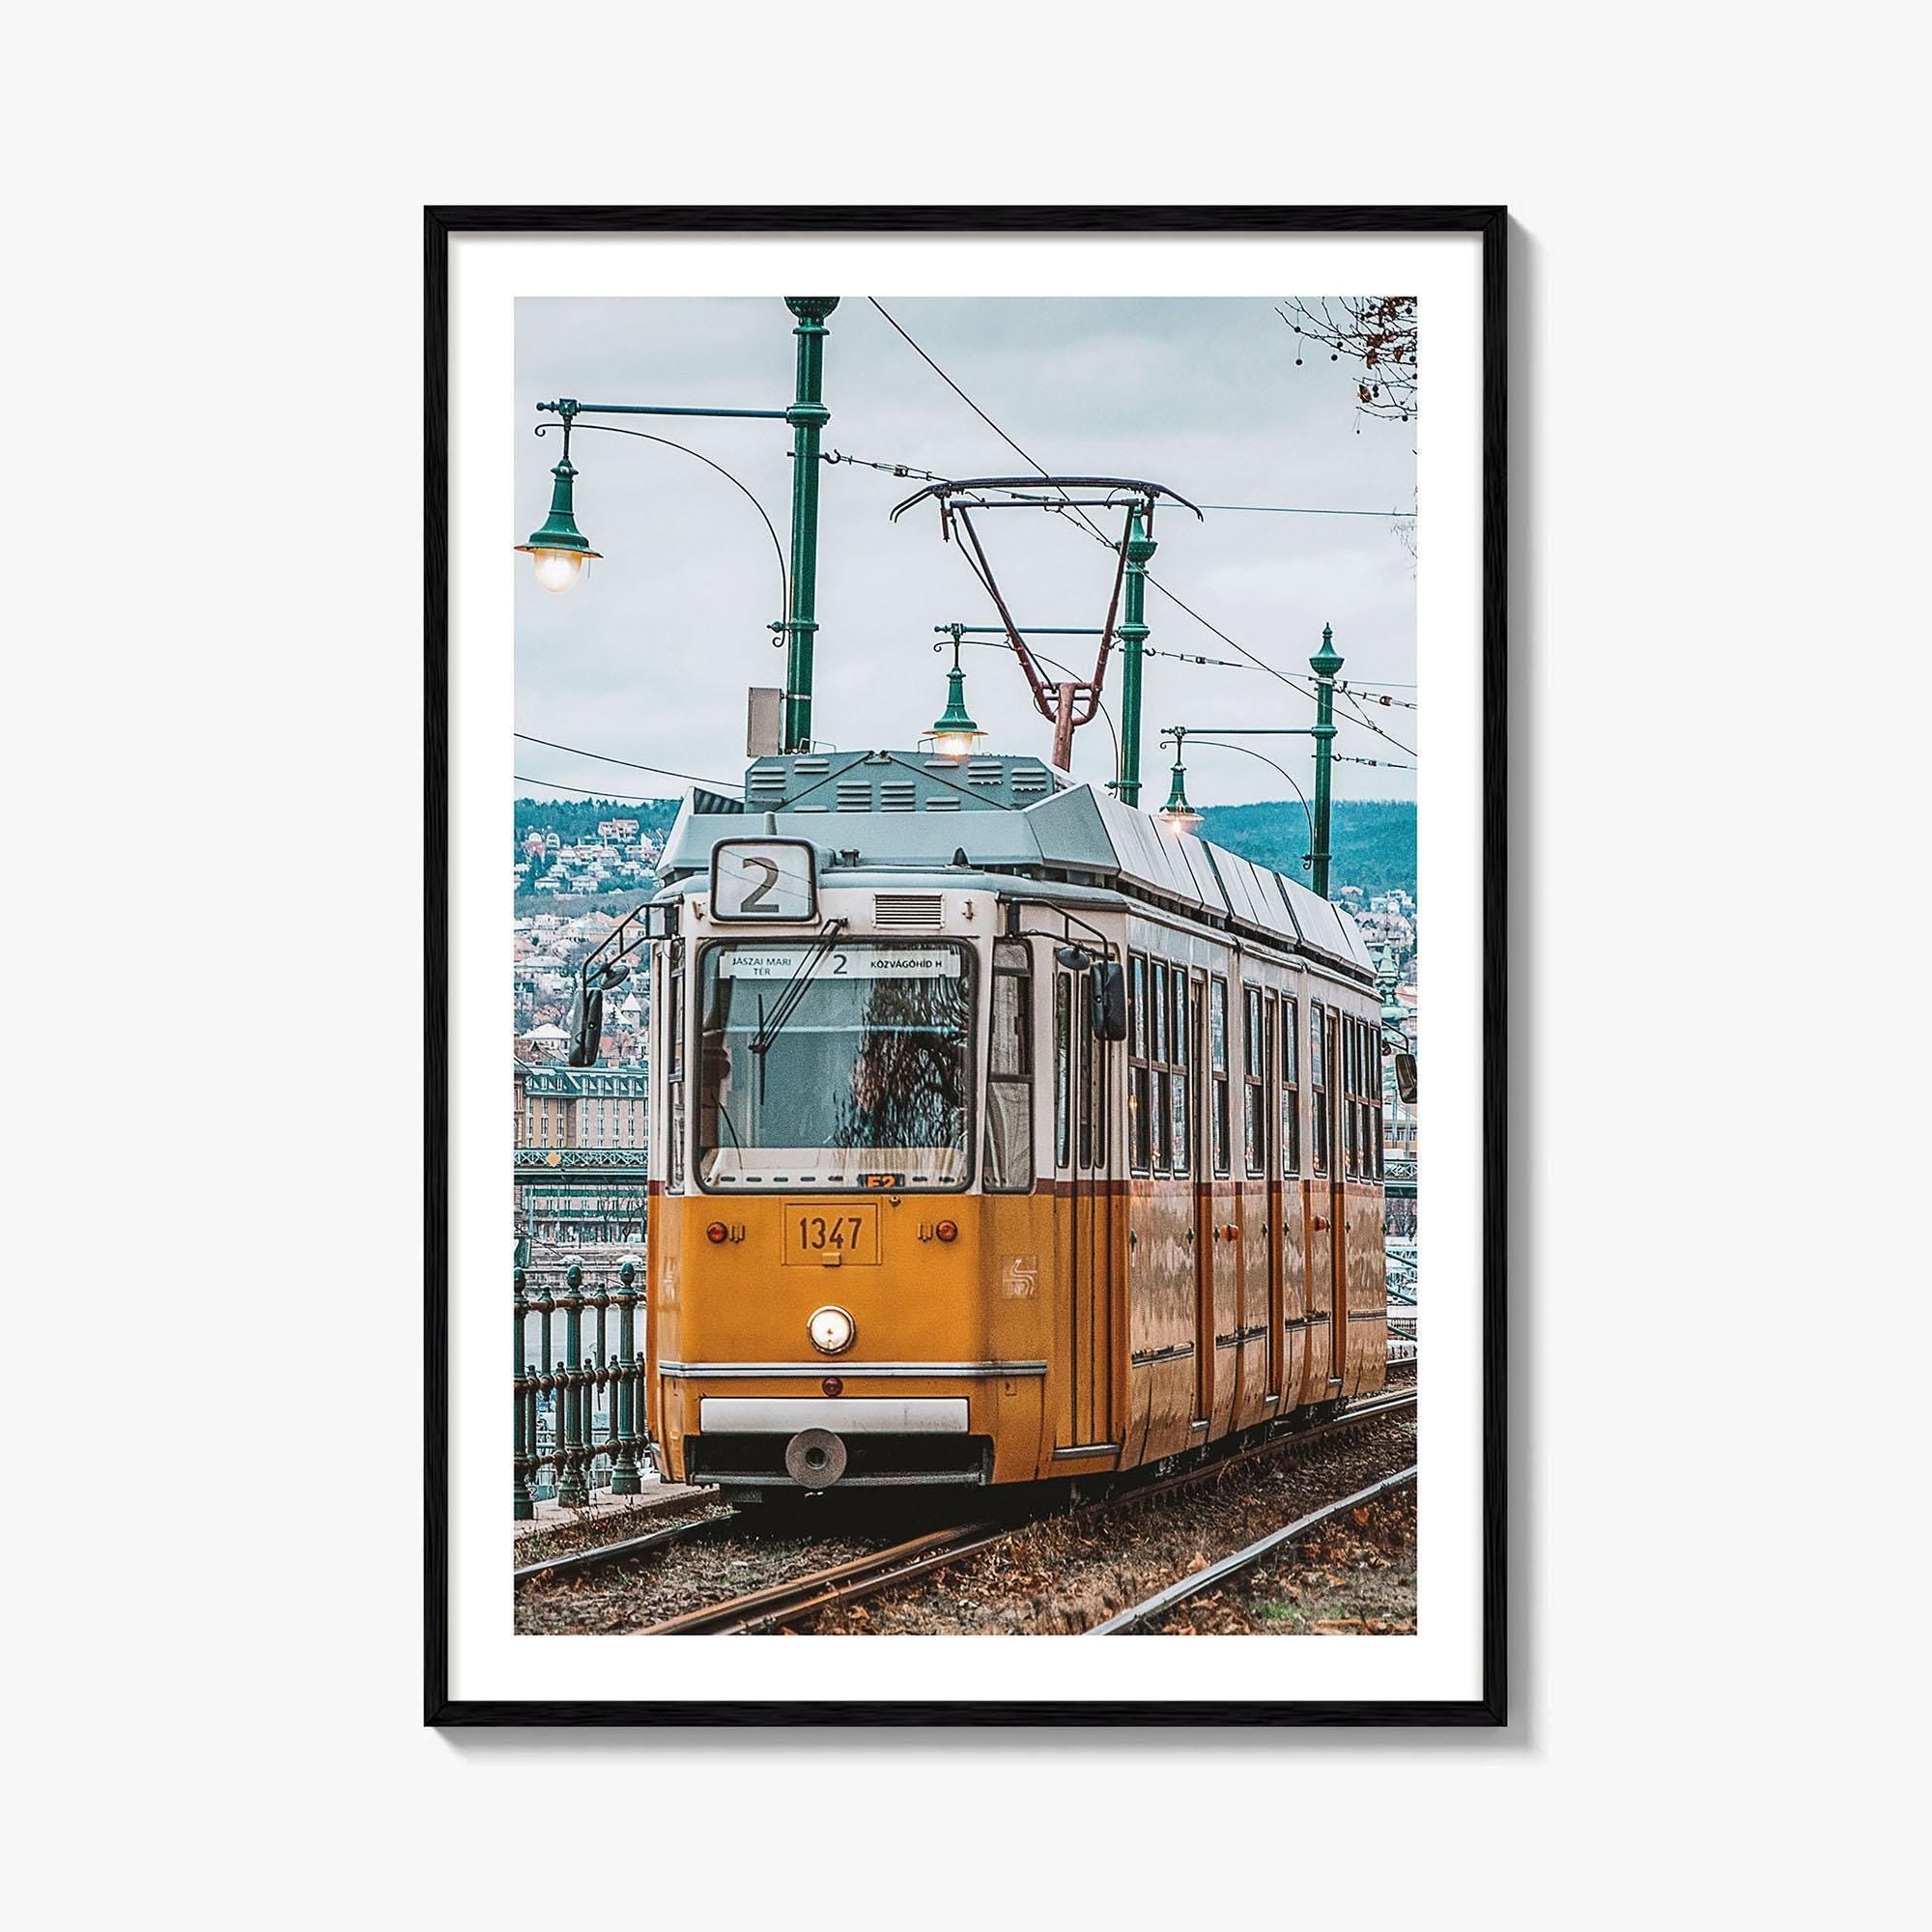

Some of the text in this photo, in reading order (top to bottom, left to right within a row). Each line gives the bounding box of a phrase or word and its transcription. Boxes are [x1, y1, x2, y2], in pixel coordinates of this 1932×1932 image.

[740, 856, 780, 913] 2
[766, 957, 792, 966] MARI
[833, 953, 848, 975] 2
[935, 960, 943, 969] H
[799, 1217, 863, 1250] 1347
